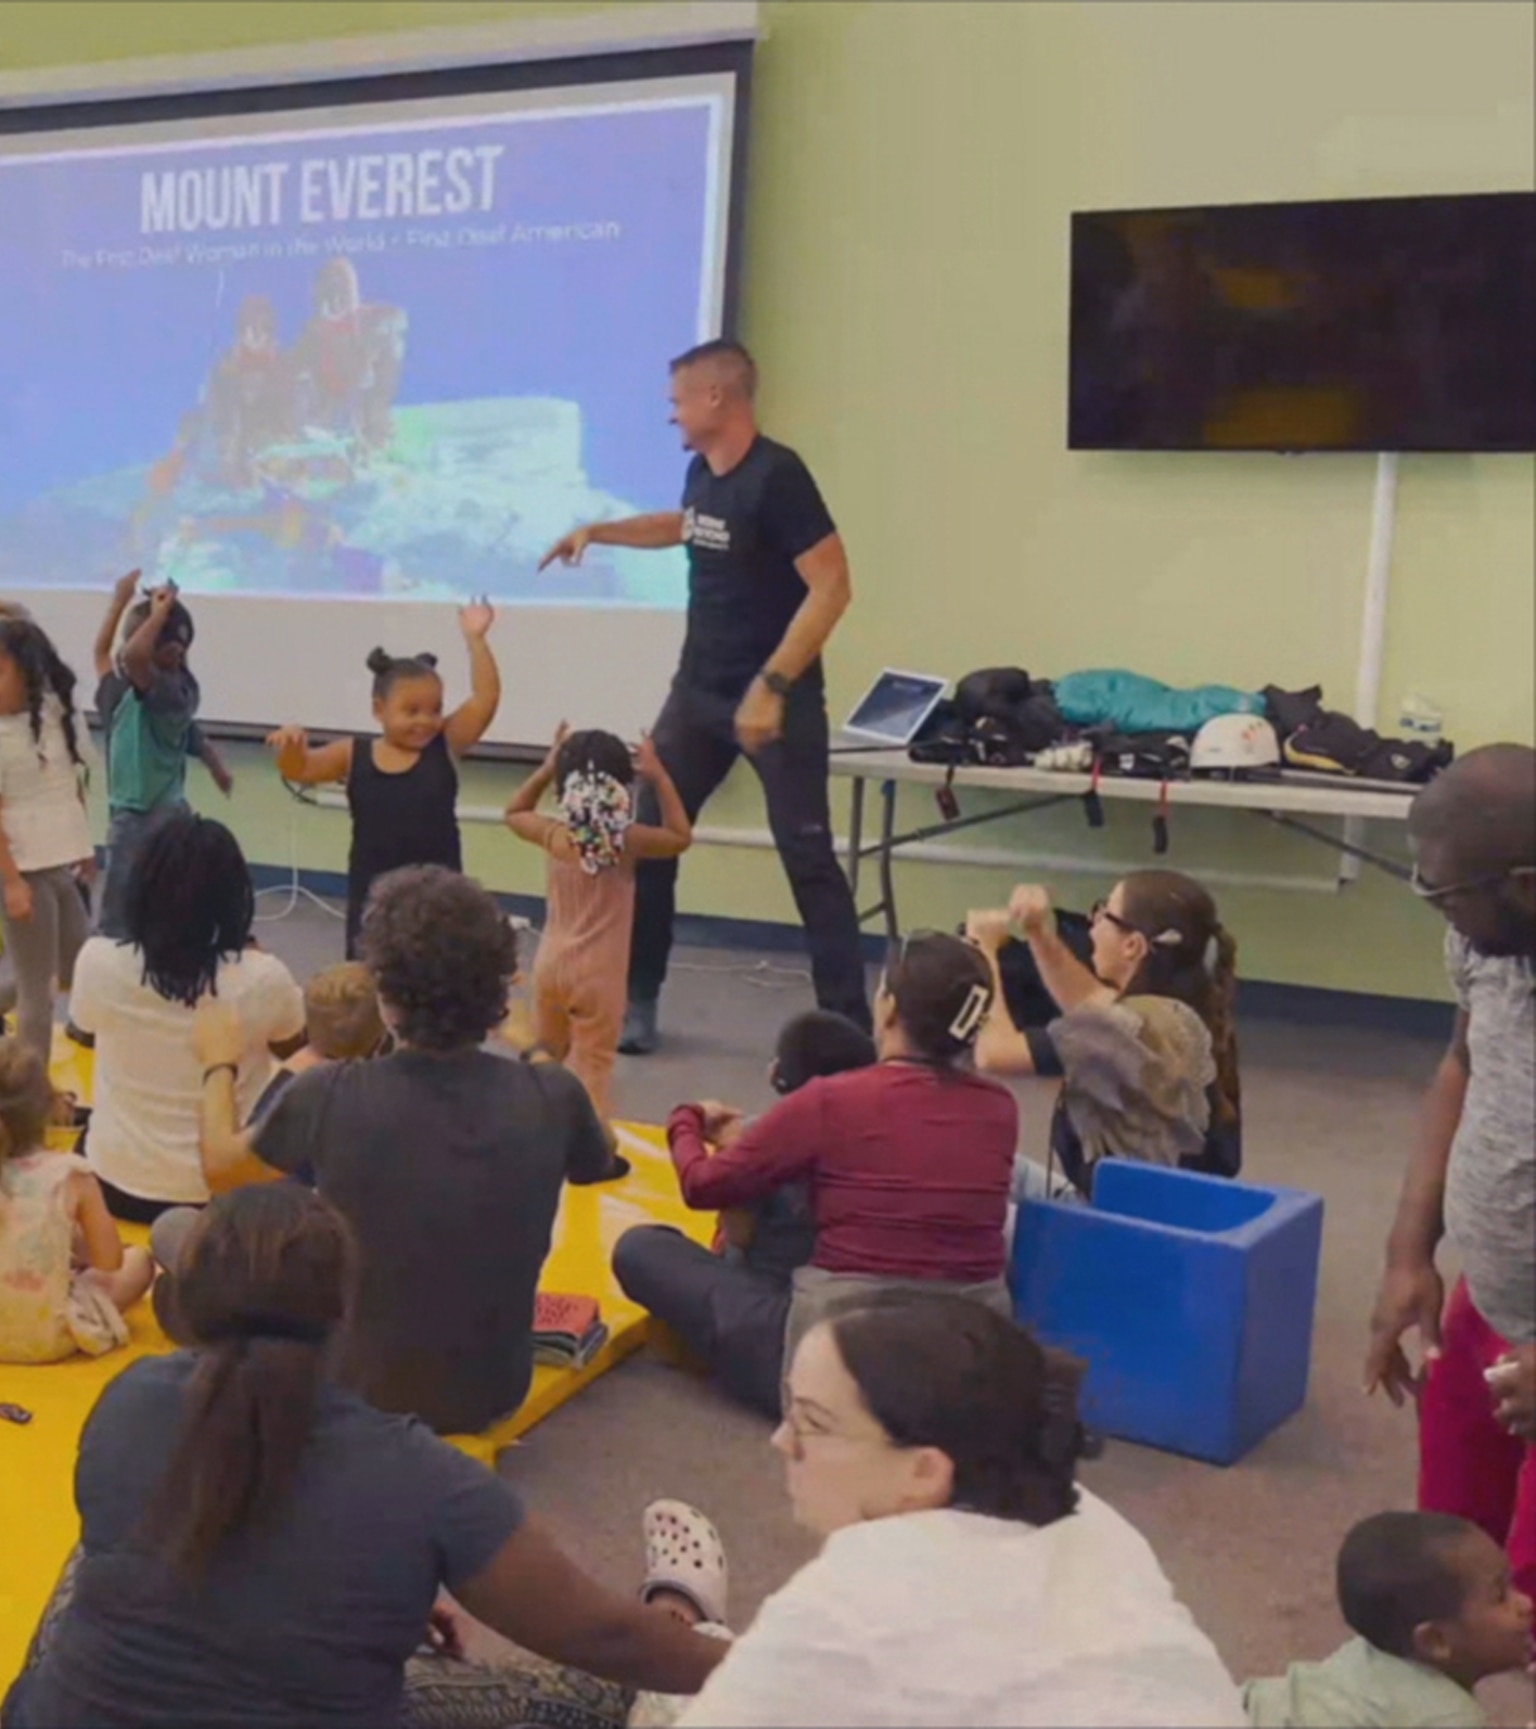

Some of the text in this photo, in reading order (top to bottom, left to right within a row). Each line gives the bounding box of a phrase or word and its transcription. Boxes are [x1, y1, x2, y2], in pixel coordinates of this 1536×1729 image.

[140, 145, 504, 233] MOUNT EVEREST
[185, 241, 259, 263] Woman
[287, 236, 318, 256] the
[323, 232, 385, 252] World
[511, 220, 621, 243] American
